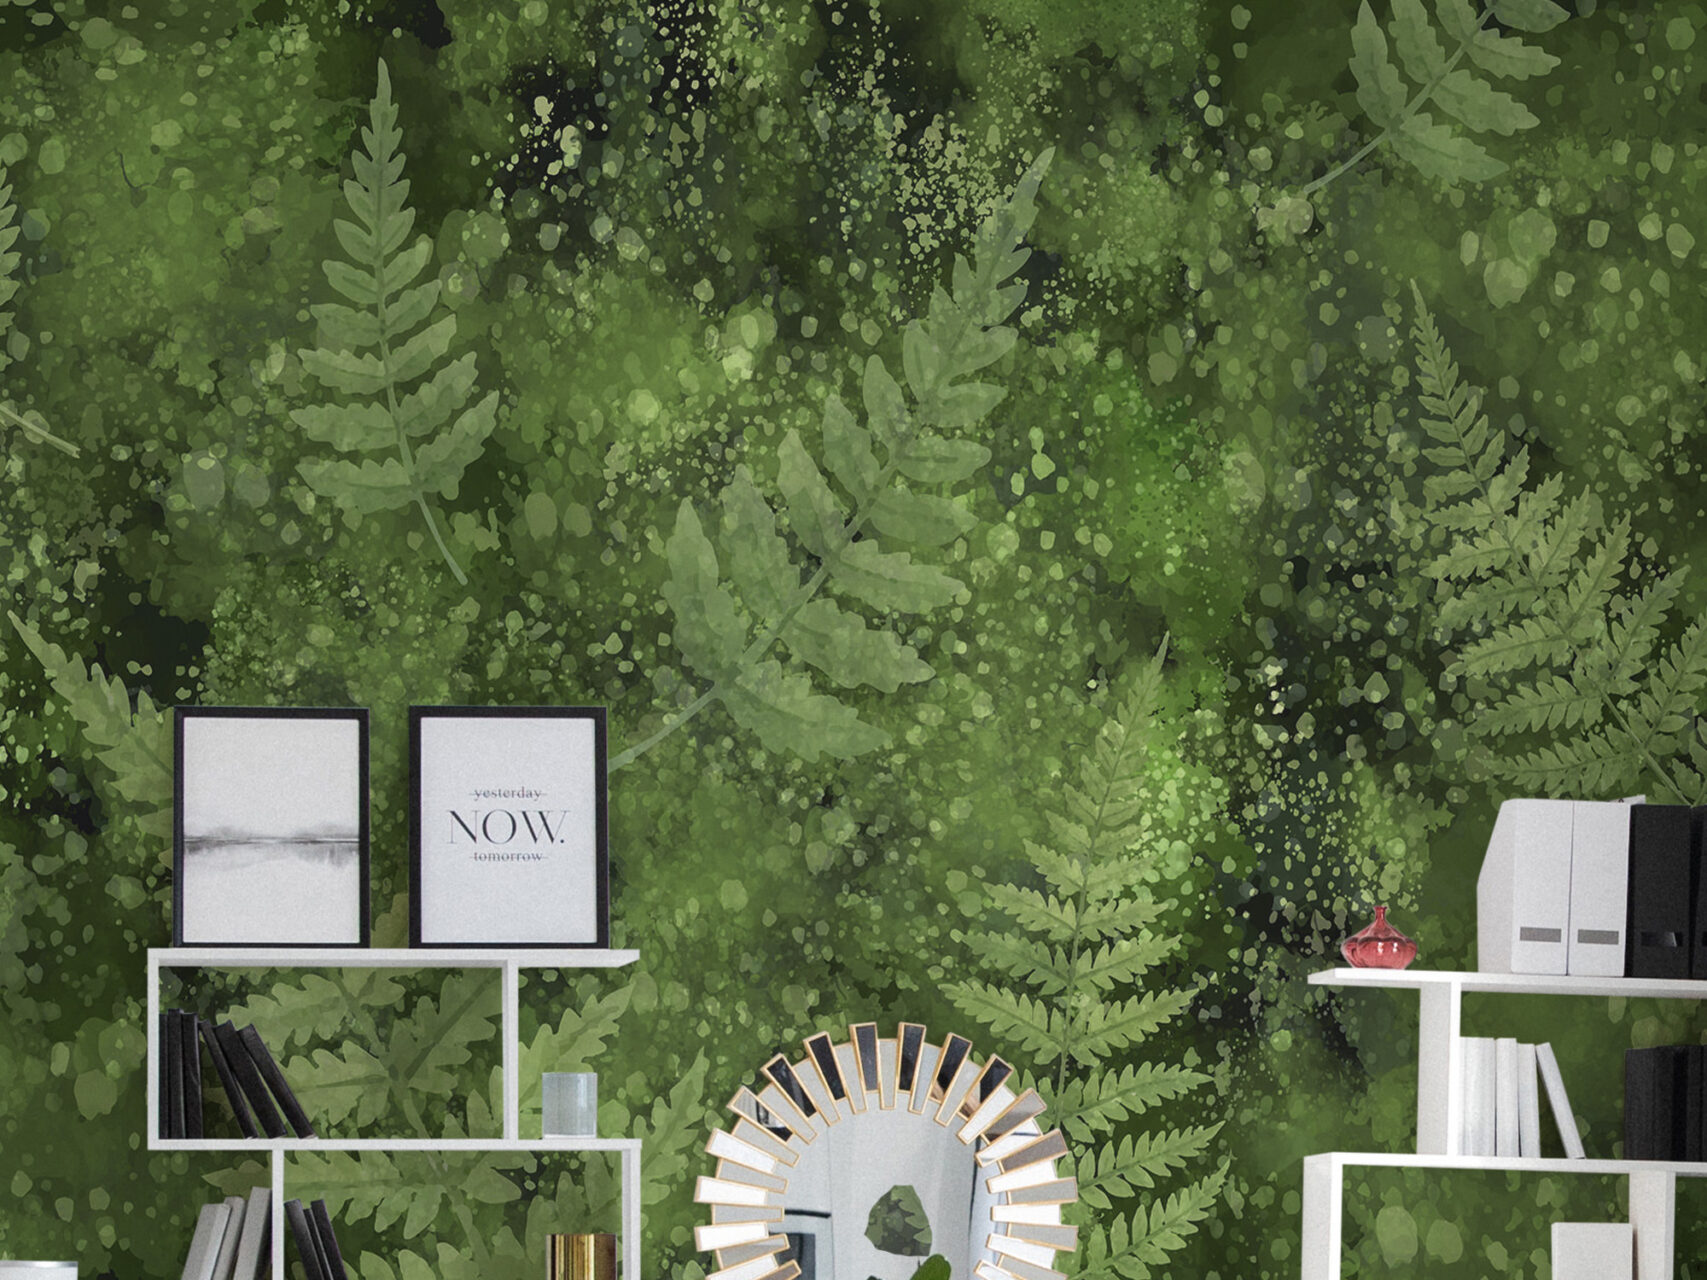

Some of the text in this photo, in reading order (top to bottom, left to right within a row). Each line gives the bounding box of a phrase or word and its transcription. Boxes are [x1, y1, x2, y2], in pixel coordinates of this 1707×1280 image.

[473, 786, 543, 801] yesterday
[447, 809, 571, 844] NOW.
[473, 851, 544, 862] tomorrow
